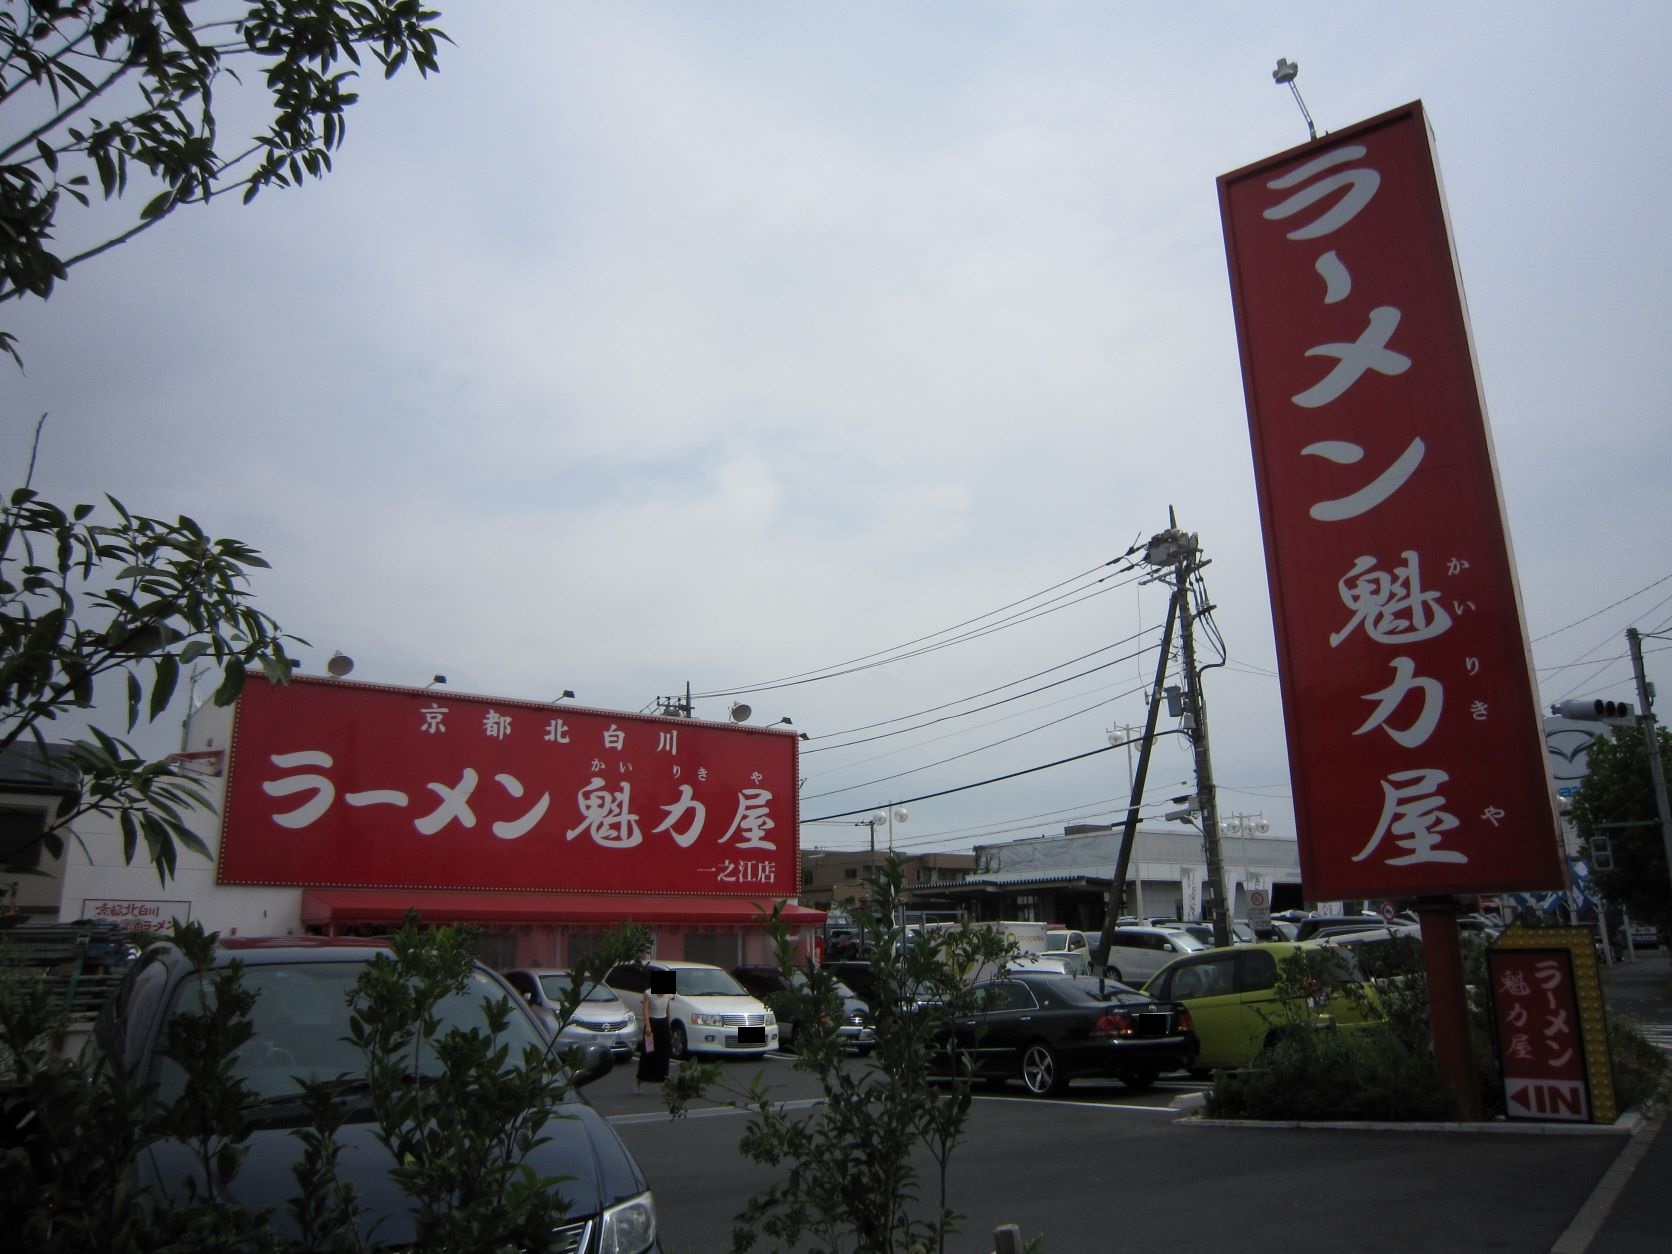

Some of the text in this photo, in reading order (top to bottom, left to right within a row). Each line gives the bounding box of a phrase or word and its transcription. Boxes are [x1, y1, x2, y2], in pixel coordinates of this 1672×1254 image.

[420, 703, 679, 756] 京都北白川
[696, 858, 776, 884] 一之江店
[1499, 970, 1534, 1060] 魁力屋
[1534, 960, 1573, 1067] ラーメン
[1534, 1084, 1583, 1116] IN
